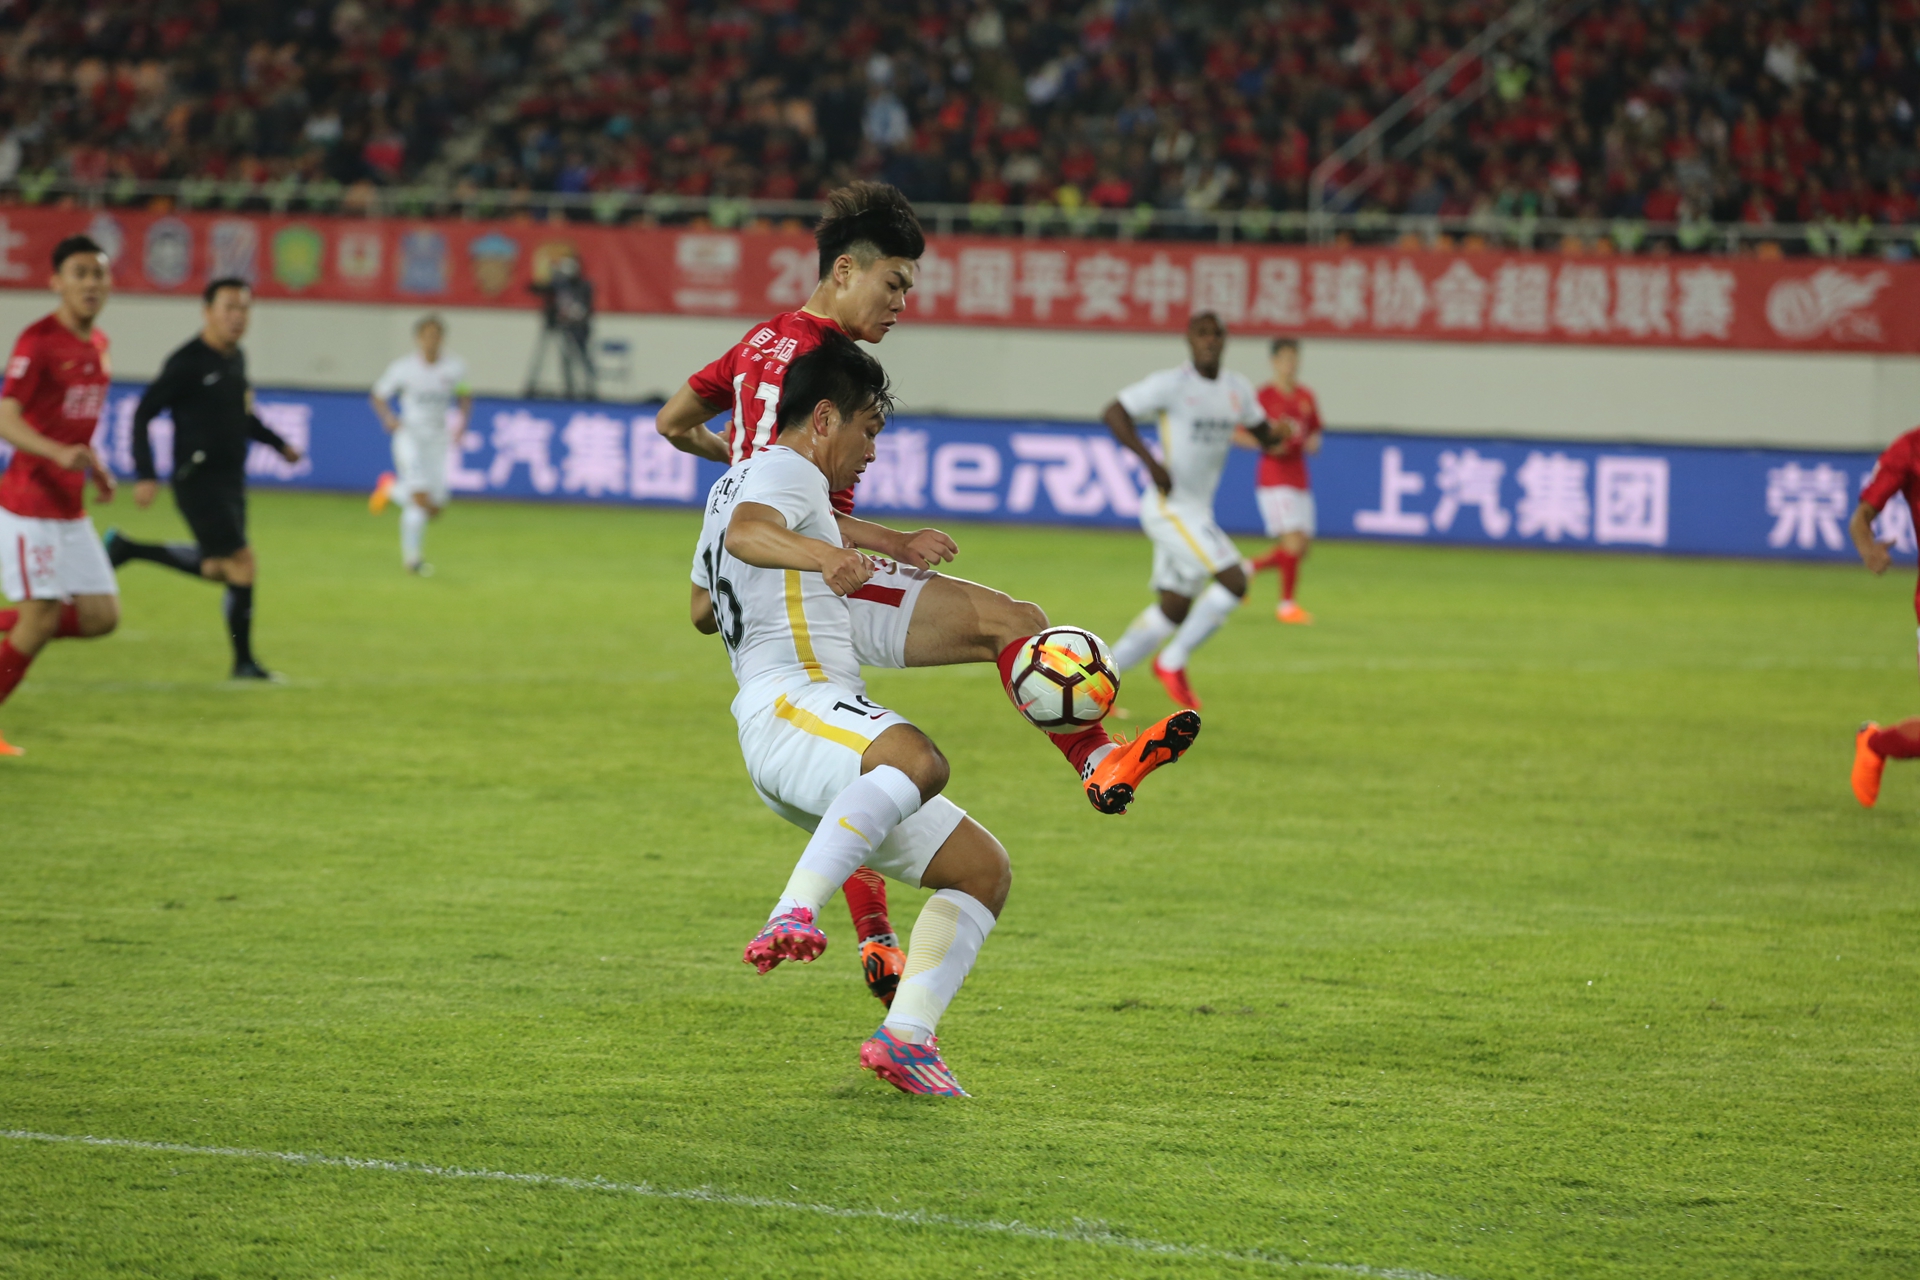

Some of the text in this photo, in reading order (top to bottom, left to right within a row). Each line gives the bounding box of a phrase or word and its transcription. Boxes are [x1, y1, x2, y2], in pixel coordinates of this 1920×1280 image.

[444, 407, 698, 500] 上汽集团
[731, 372, 780, 466] 17
[1353, 445, 1670, 547] 上汽集团
